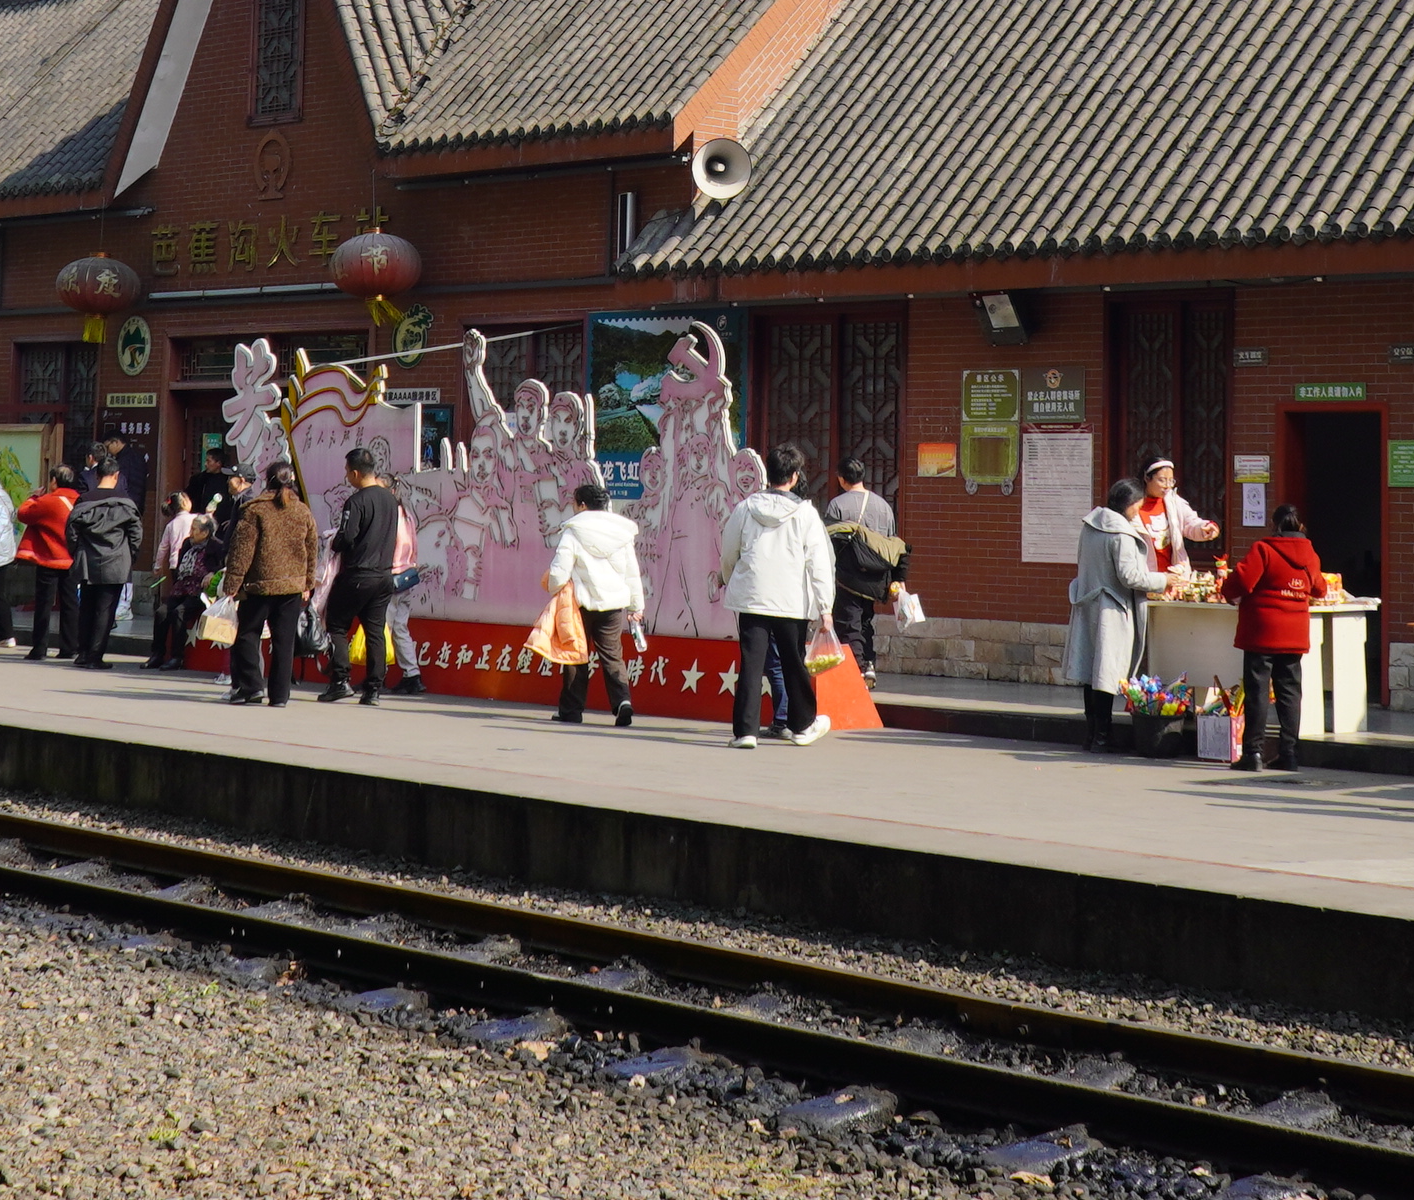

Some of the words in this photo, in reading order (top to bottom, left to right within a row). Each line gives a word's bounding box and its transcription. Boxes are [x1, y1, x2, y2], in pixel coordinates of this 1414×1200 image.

[385, 390, 437, 402] 家AAAA旅游景区
[597, 460, 640, 481] 龙飞虹
